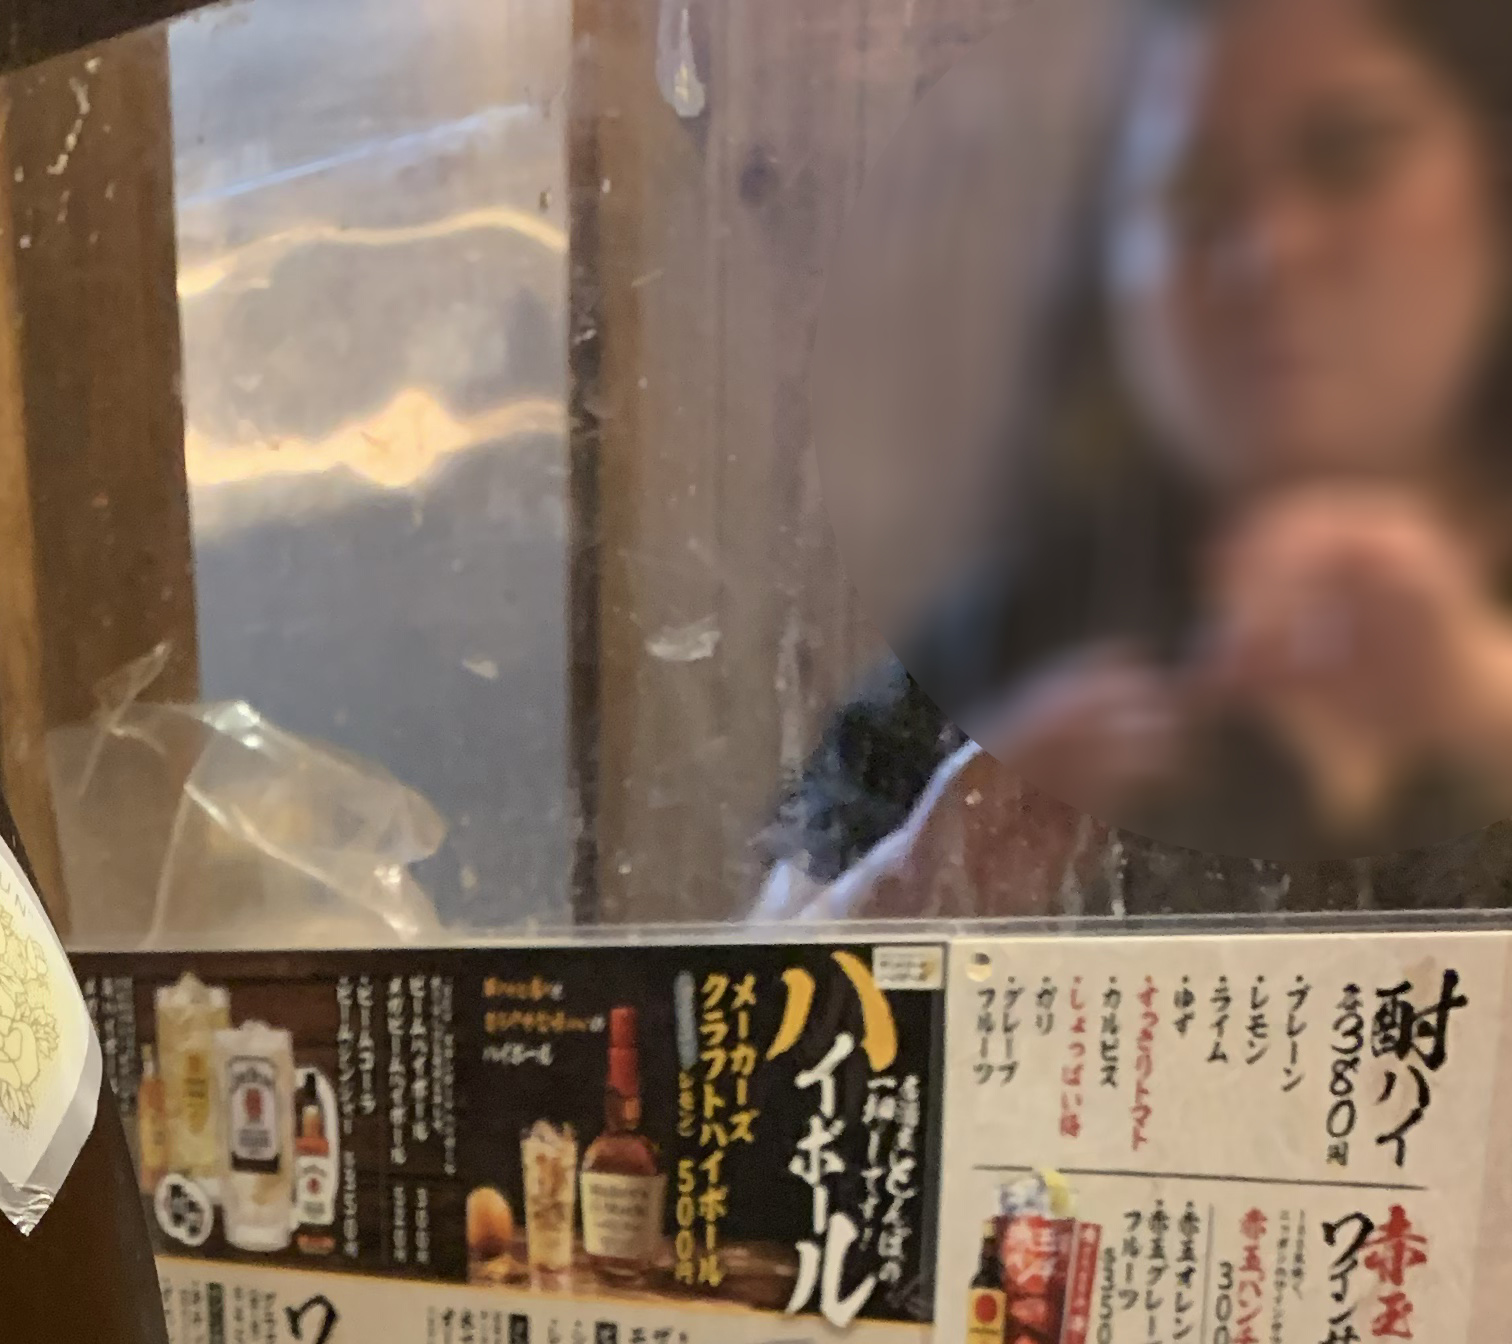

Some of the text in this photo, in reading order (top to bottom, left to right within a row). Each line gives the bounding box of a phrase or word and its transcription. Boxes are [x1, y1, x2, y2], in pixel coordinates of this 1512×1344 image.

[731, 972, 761, 1143] メーカーズ
[1206, 985, 1232, 1063] ライム
[1245, 985, 1271, 1065] レモン
[1370, 967, 1470, 1168] 酎ハイ
[698, 972, 731, 1287] クラフトハイボール
[765, 950, 899, 1328] ハイボール
[1360, 1203, 1429, 1339] 赤玉
